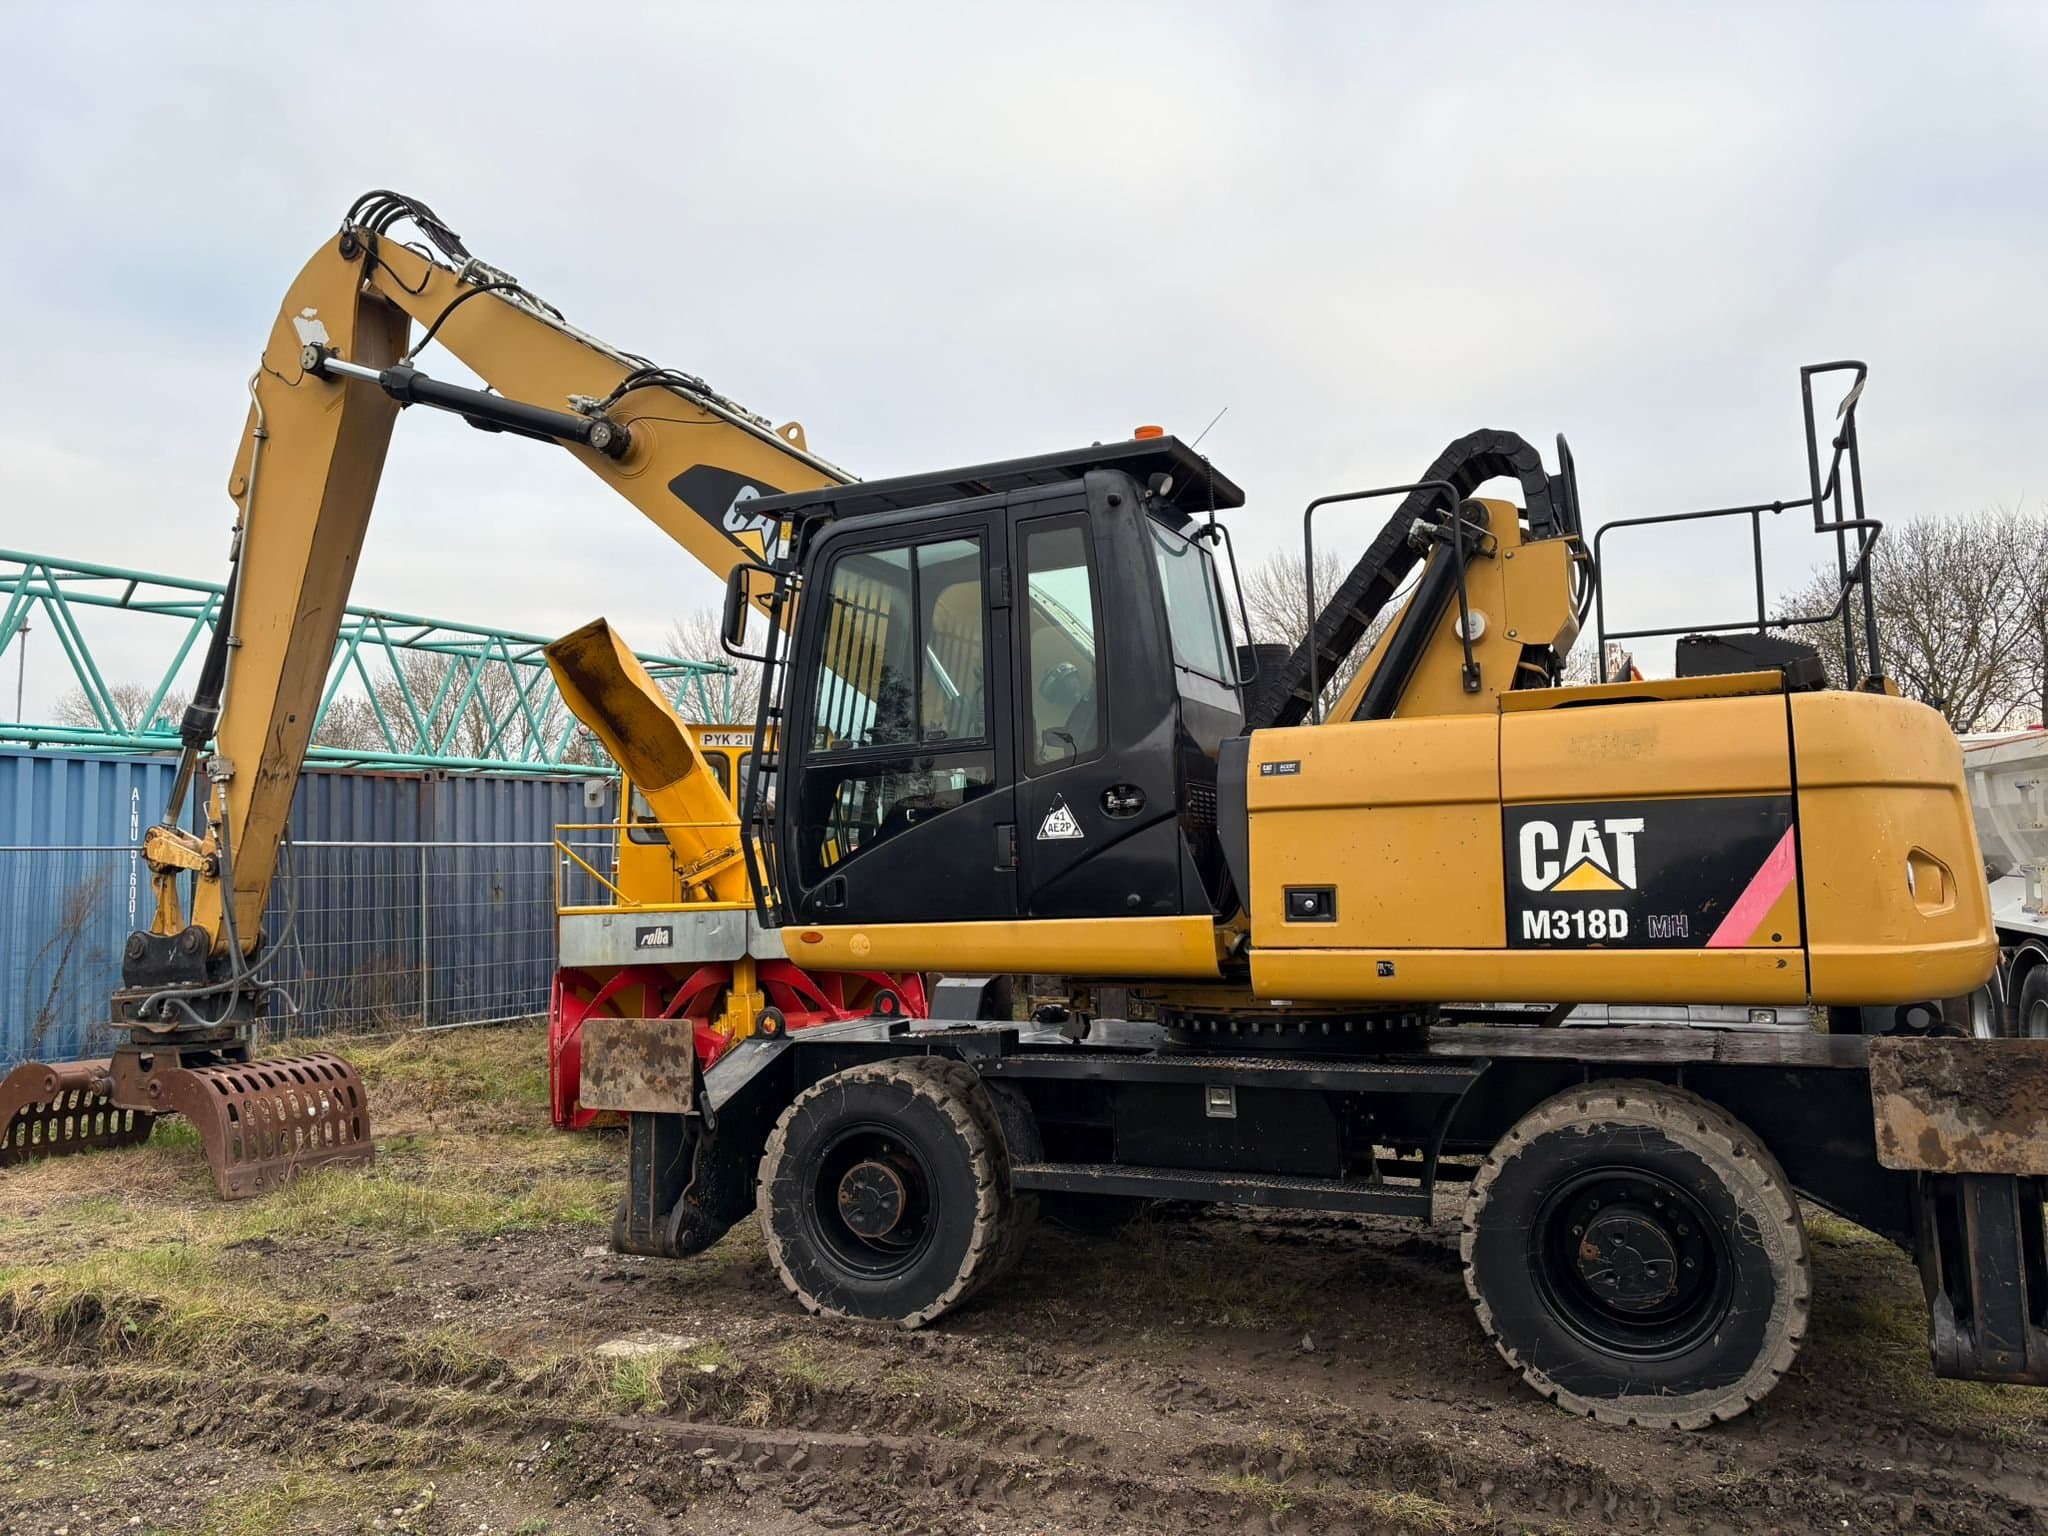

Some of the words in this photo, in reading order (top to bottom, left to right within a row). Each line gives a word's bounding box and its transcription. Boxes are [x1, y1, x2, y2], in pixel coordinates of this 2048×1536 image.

[723, 485, 778, 566] CA
[704, 734, 730, 745] PYK
[130, 787, 139, 841] ALNU
[1047, 822, 1072, 833] AE2P
[1053, 811, 1065, 821] 41
[1519, 818, 1645, 892] CAT
[1522, 909, 1629, 940] M318D
[1648, 914, 1689, 939] MH
